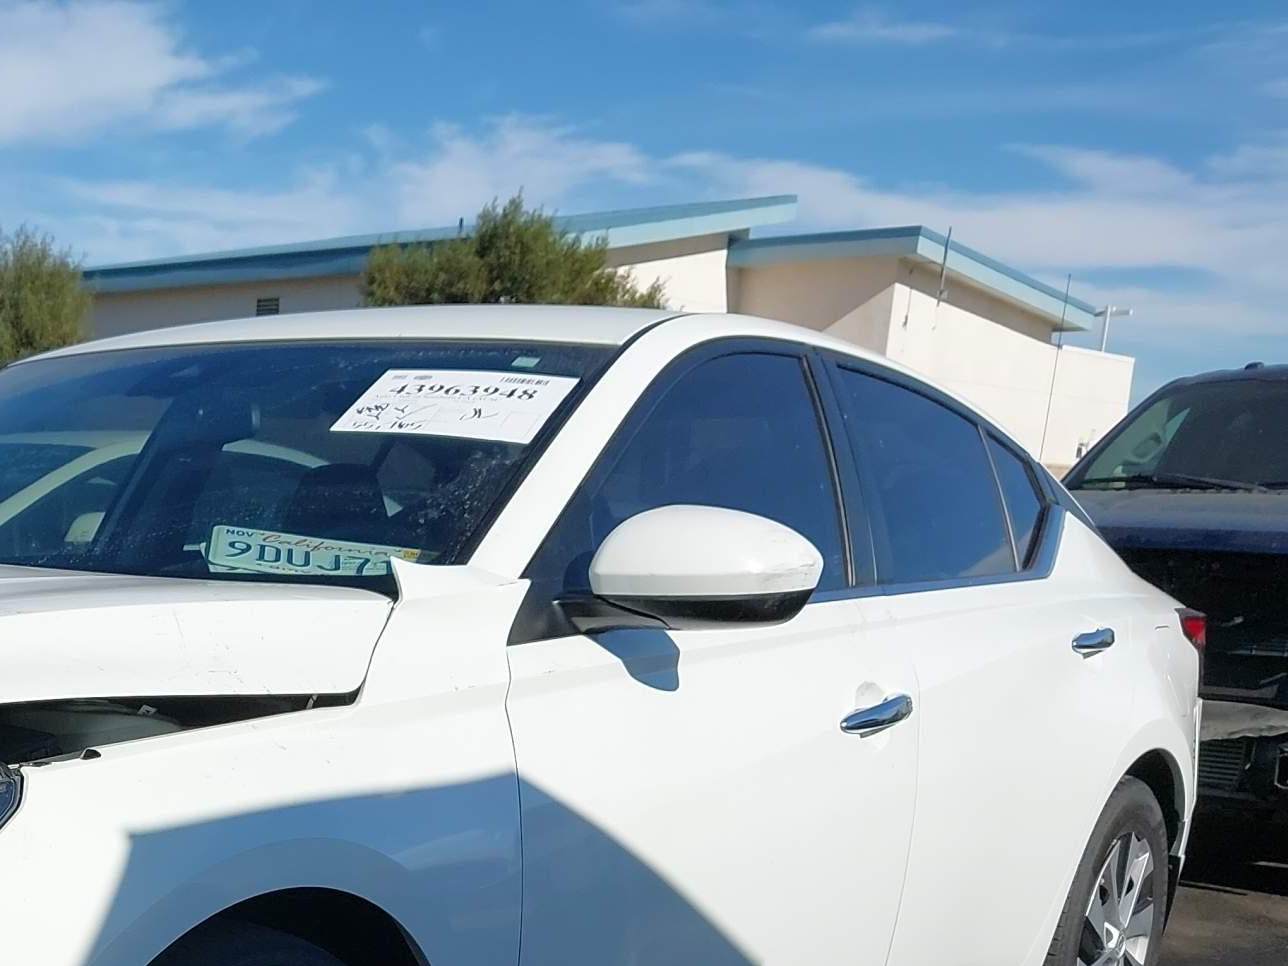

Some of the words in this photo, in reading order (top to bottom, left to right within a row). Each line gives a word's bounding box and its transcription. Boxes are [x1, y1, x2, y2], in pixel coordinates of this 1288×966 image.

[389, 383, 538, 400] 43963948
[225, 528, 254, 537] NOV
[261, 533, 388, 557] California
